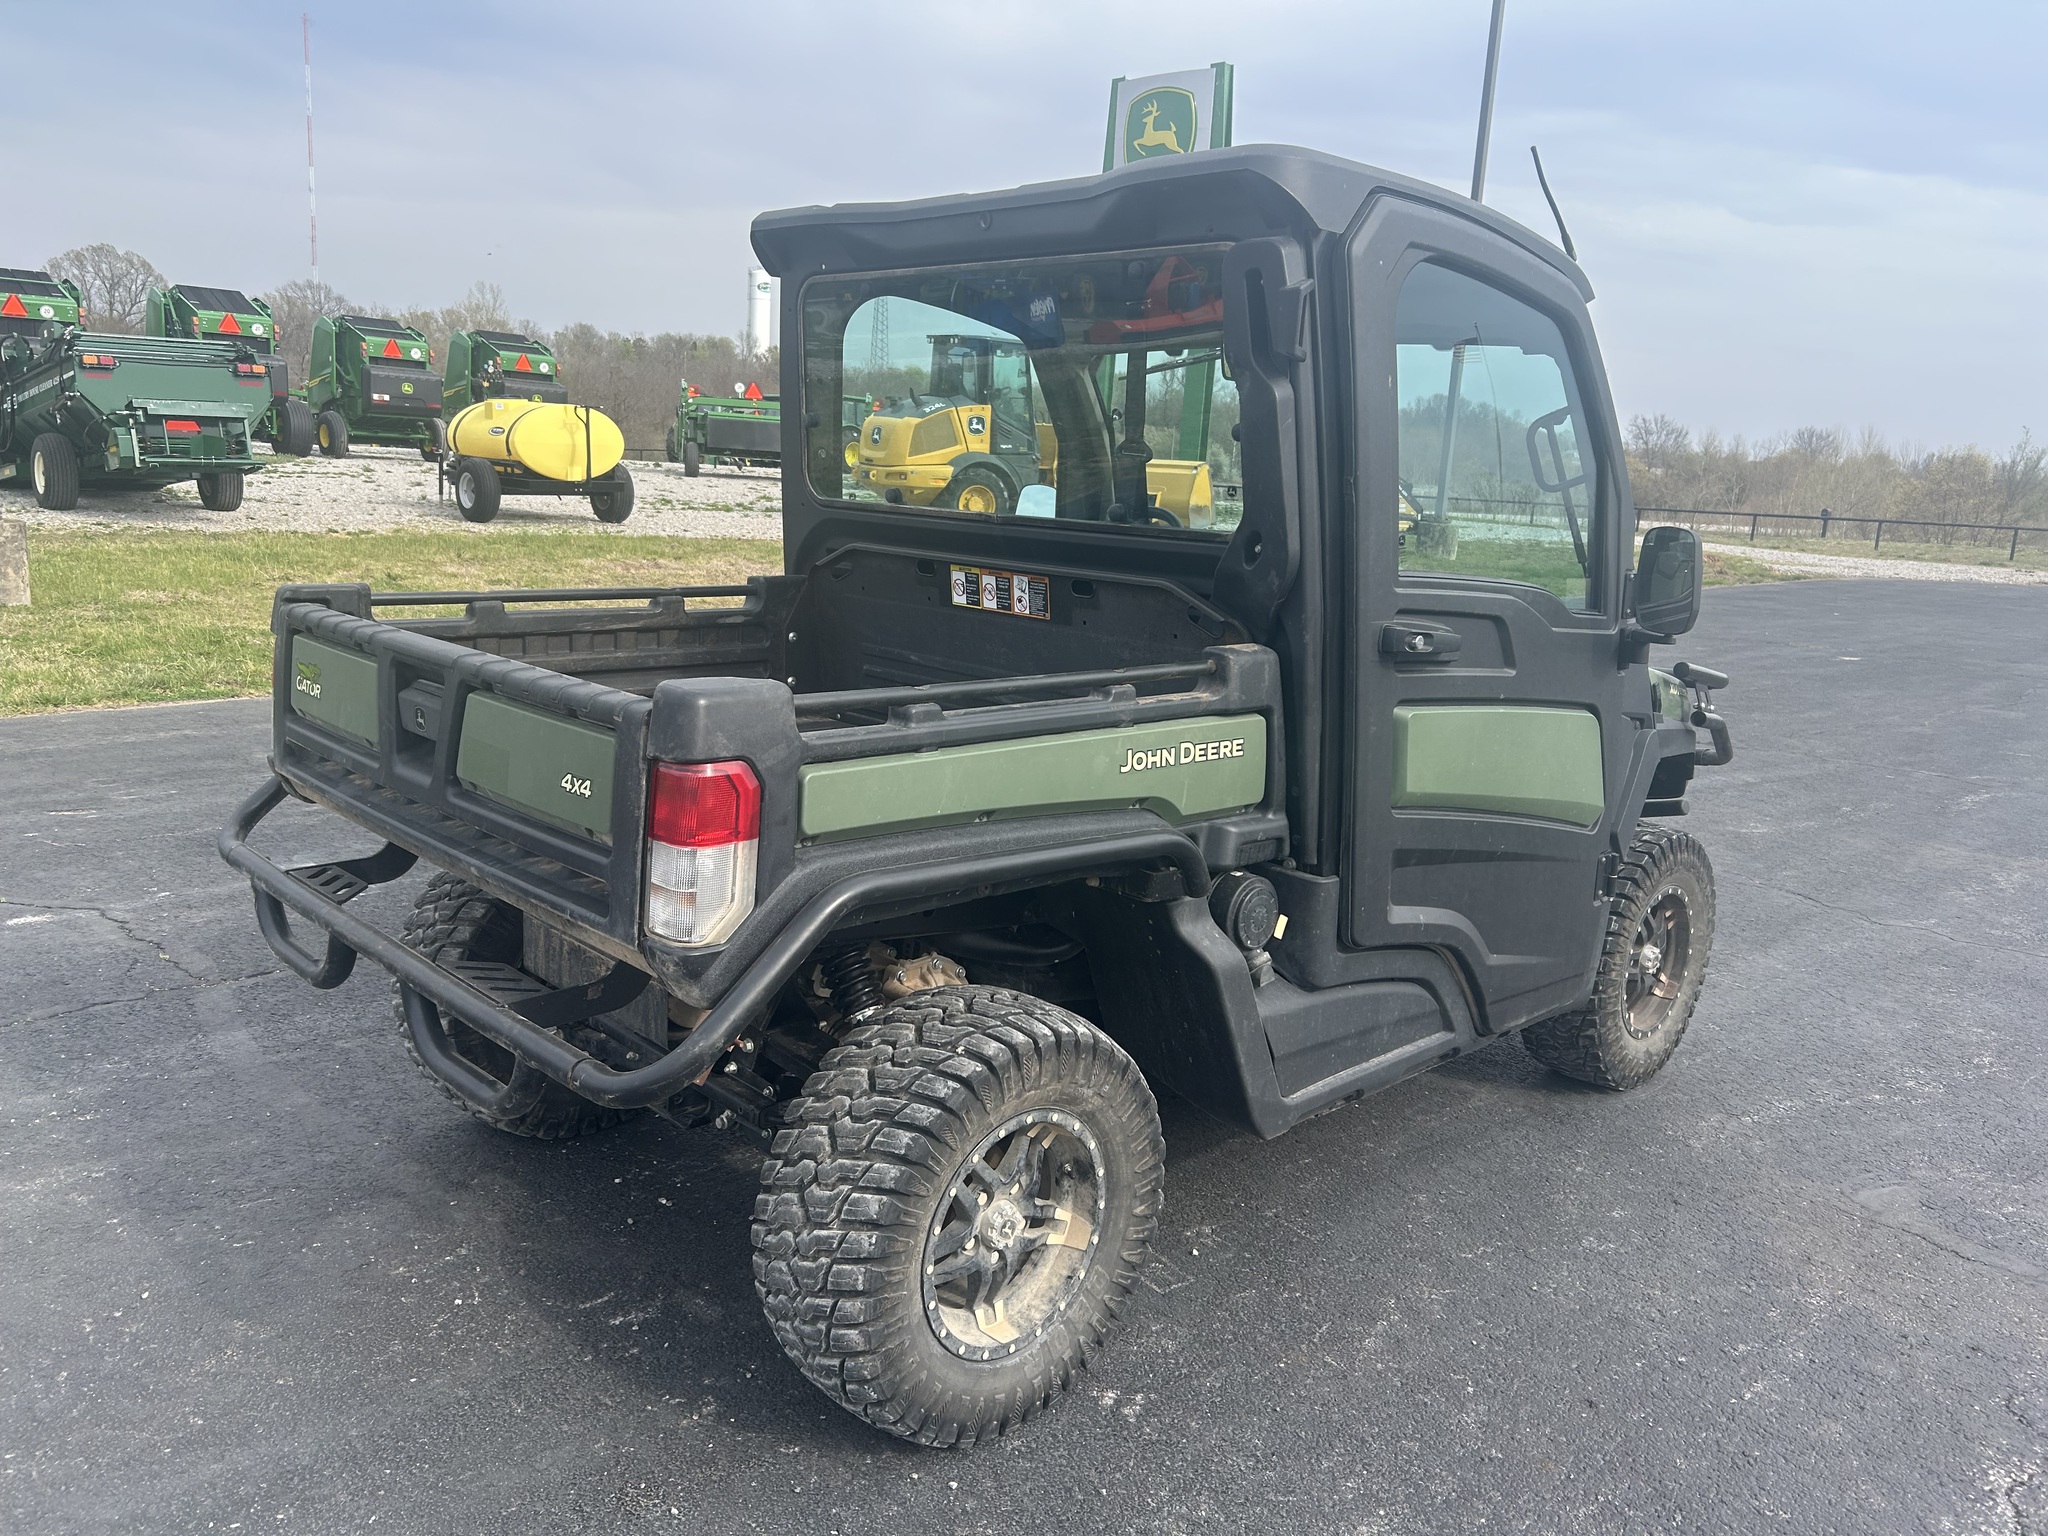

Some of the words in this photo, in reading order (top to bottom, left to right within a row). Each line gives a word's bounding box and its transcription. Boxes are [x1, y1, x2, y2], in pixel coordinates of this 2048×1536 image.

[296, 675, 322, 699] GATOR
[1120, 747, 1176, 773] JOHN
[1179, 738, 1245, 765] DEERE
